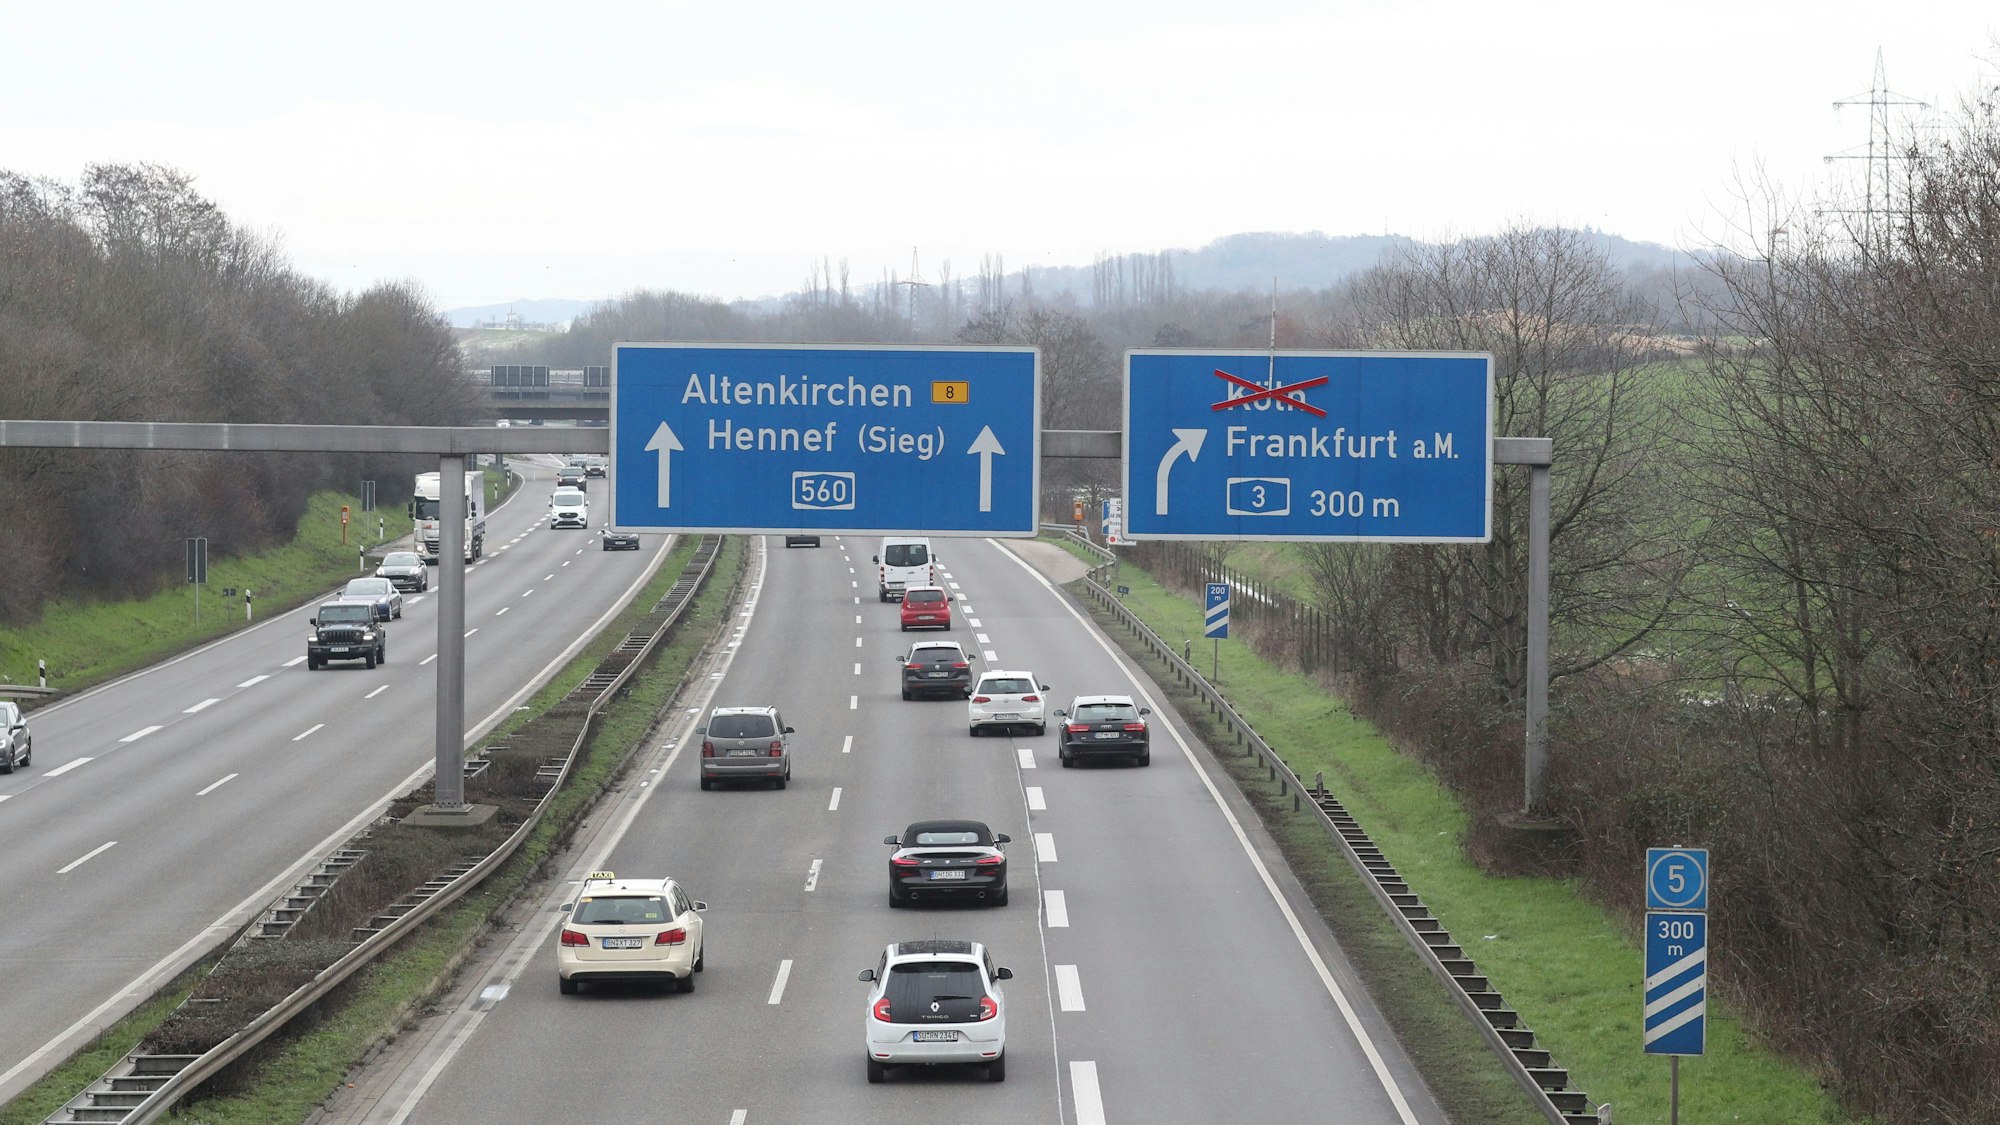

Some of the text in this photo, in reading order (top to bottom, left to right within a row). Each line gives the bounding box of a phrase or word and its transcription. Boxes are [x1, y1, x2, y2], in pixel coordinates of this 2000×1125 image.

[681, 373, 955, 407] Altenkirchen 8
[1227, 380, 1306, 412] Köln
[708, 418, 945, 462] Hennef (Sieg)
[1227, 425, 1459, 459] Frankfurt a.M.
[801, 479, 847, 503] 560
[1251, 485, 1400, 518] 3 300 m
[1210, 586, 1225, 594] 200
[1668, 865, 1685, 893] 5
[1658, 920, 1694, 940] 300
[1667, 943, 1683, 956] m
